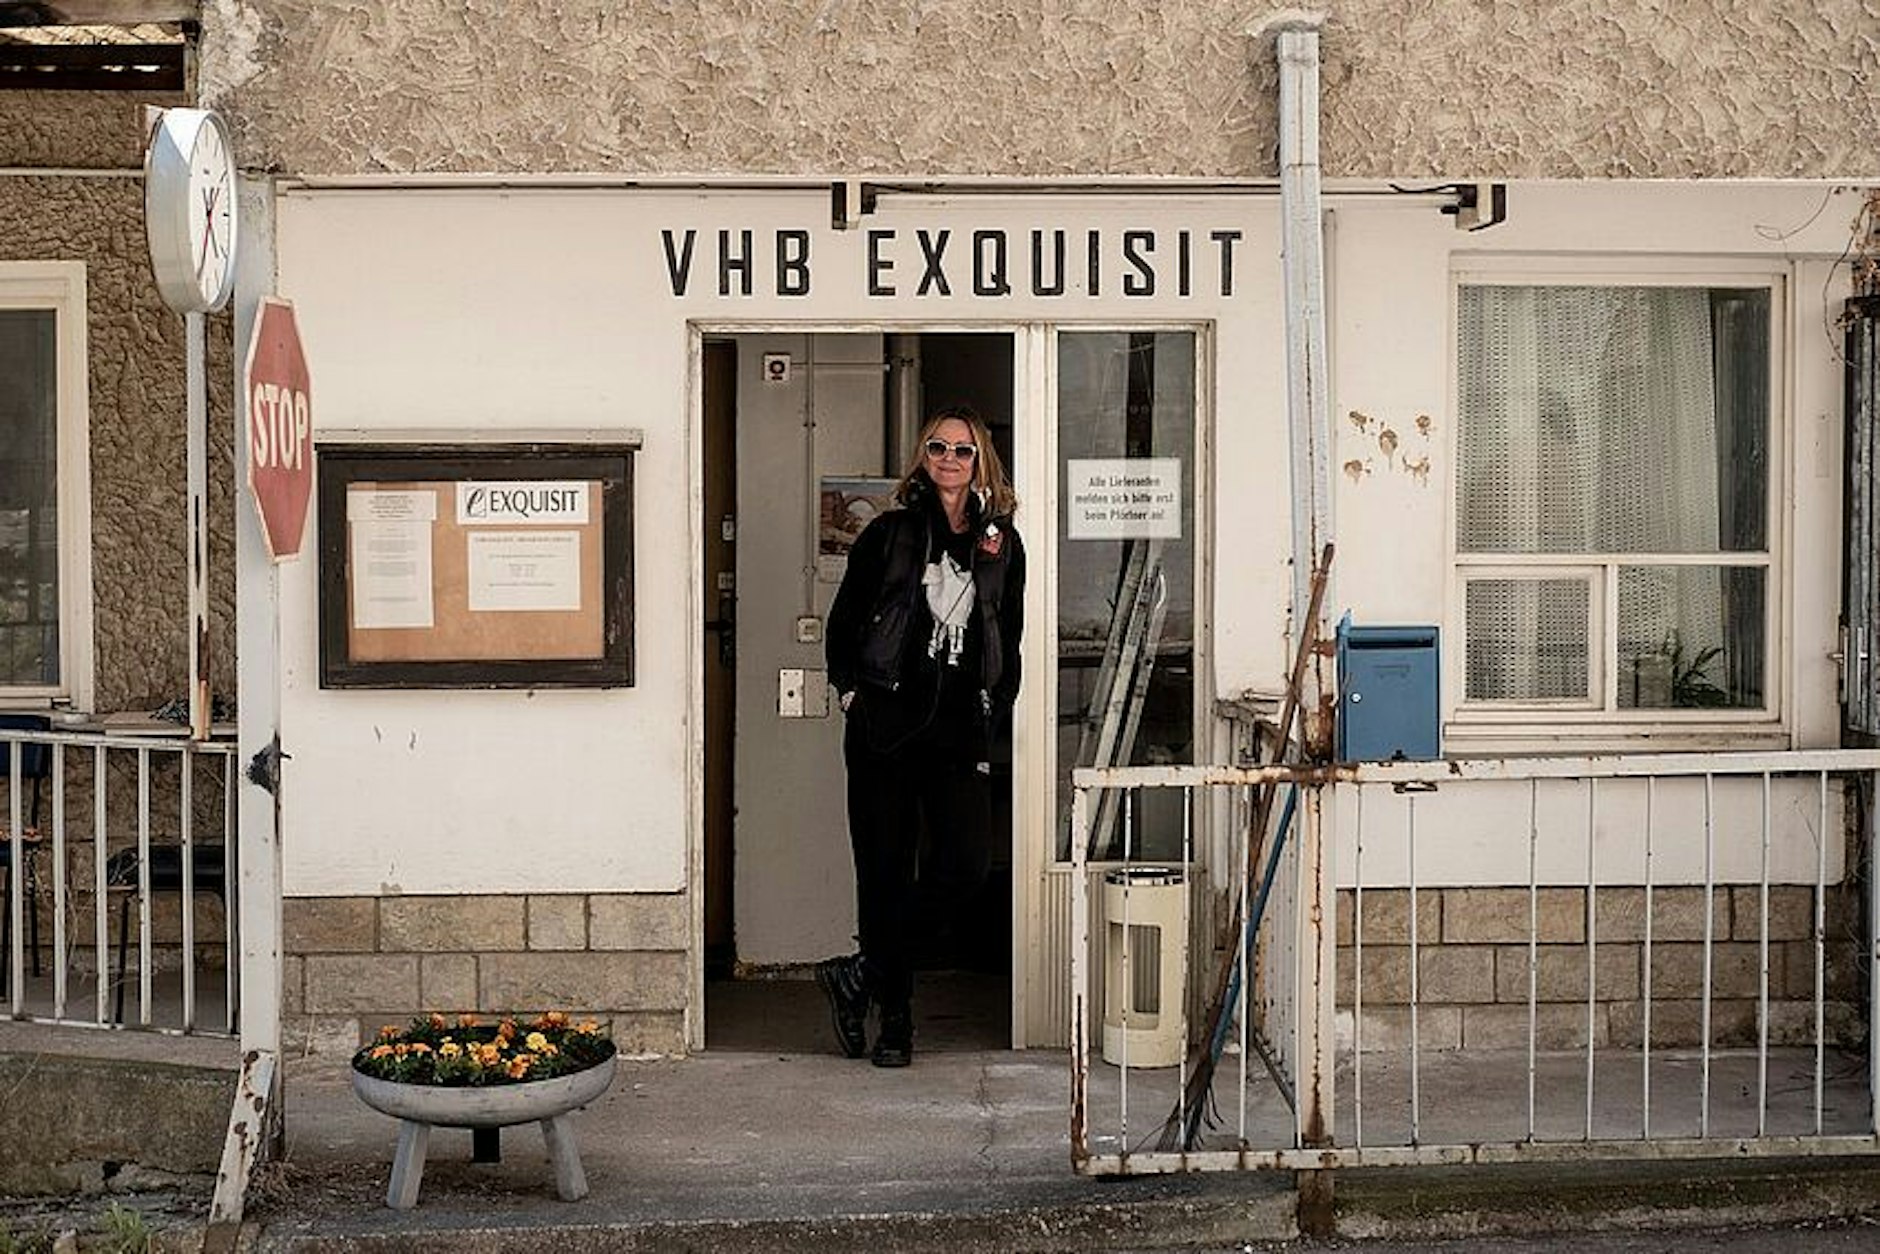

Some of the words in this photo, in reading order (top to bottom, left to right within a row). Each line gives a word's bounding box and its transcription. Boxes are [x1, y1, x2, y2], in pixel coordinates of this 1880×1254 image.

[661, 229, 811, 297] VHB
[867, 229, 1243, 297] EXQUISIT
[253, 381, 309, 471] STOP
[490, 490, 580, 518] EXQUISIT
